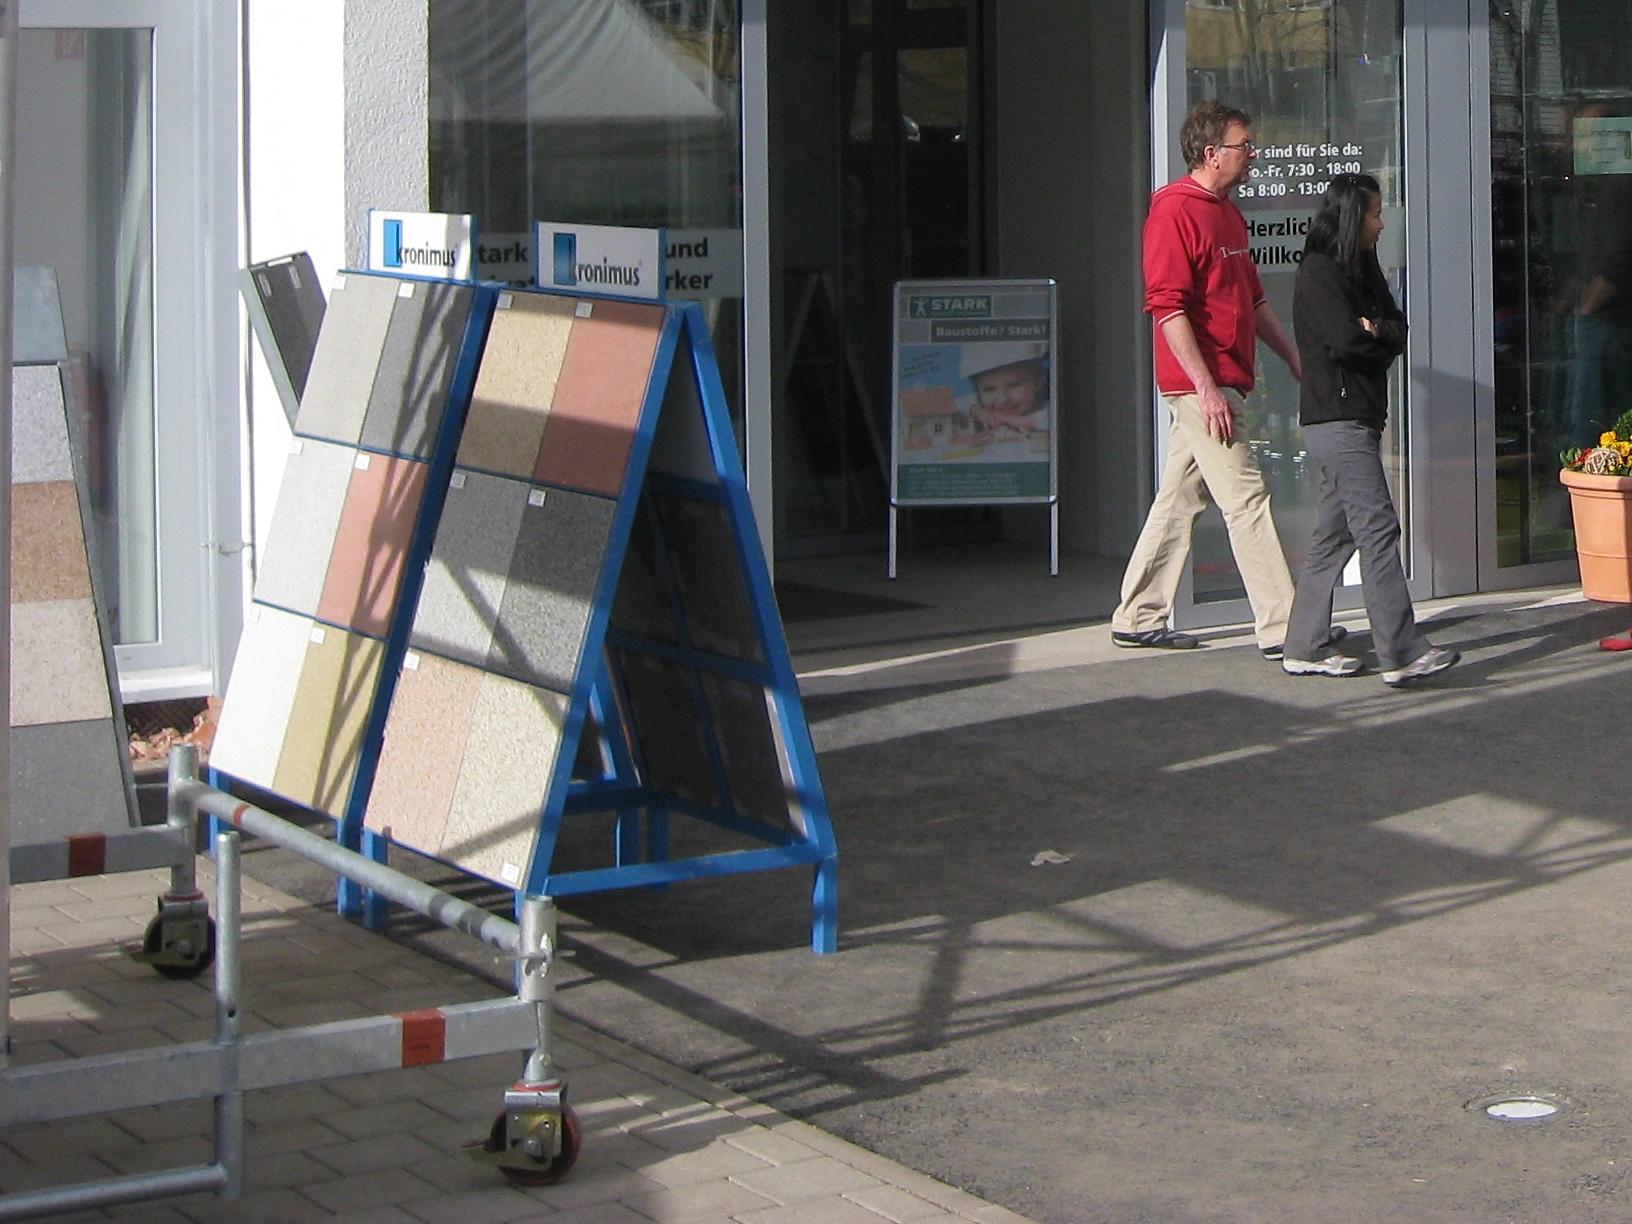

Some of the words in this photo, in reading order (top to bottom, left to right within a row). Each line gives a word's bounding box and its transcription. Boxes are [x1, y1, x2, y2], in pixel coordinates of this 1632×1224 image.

[1264, 144, 1293, 158] sind
[1295, 143, 1316, 157] für
[1320, 143, 1339, 157] Sie
[1342, 142, 1363, 156] da:
[1287, 163, 1315, 177] 7:30
[1326, 161, 1361, 175] 18:00
[1238, 184, 1254, 197] Sa
[1258, 183, 1286, 196] 8:00
[477, 241, 528, 264] tark
[1250, 246, 1304, 264] Willko
[931, 298, 988, 310] STARK
[1008, 323, 1046, 336] Stark!
